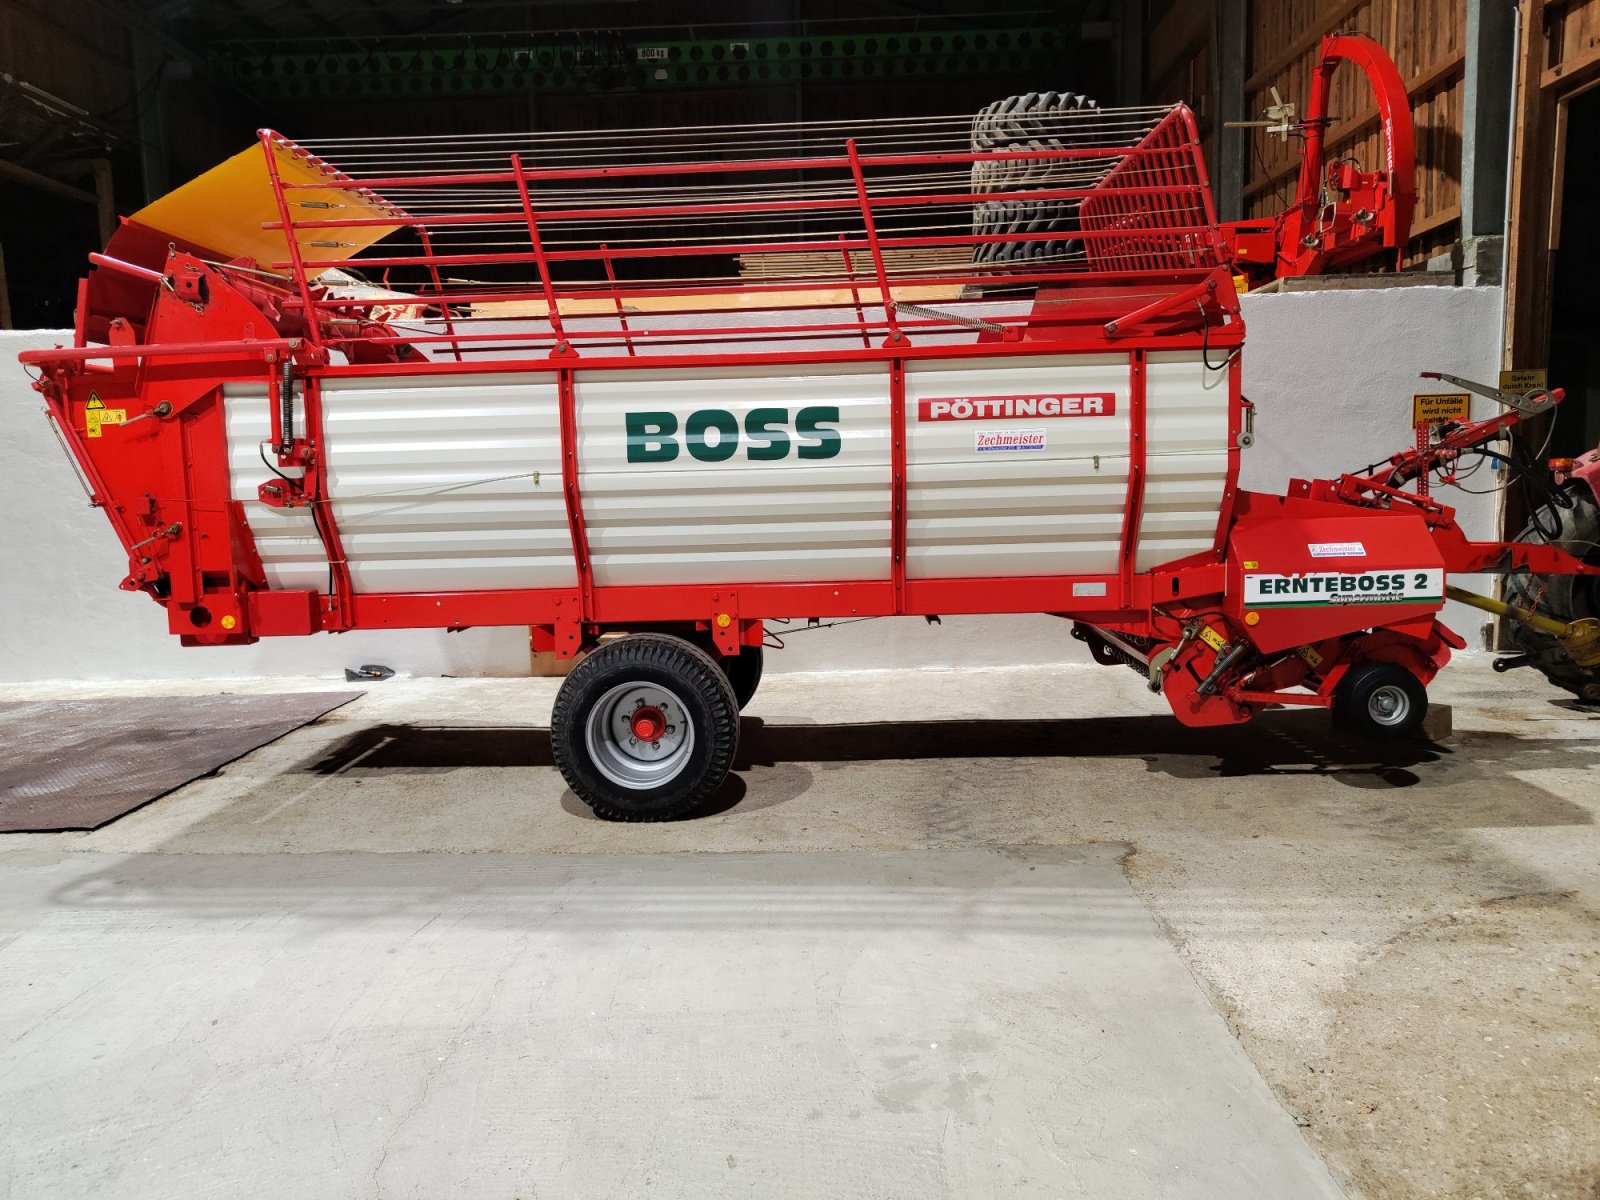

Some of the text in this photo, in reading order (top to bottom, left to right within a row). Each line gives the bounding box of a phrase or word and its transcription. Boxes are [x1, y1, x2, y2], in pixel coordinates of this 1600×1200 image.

[641, 49, 664, 58] 800 kg
[1502, 382, 1524, 390] durch
[1420, 396, 1463, 406] Für Unfälle
[930, 397, 1104, 419] PÖTTINGER
[1422, 406, 1462, 415] wird nicht
[625, 406, 842, 463] BOSS
[977, 433, 1045, 446] Zechmeister
[1259, 573, 1428, 594] ERNTEBOSS 2
[1328, 592, 1404, 605] Supermatic
